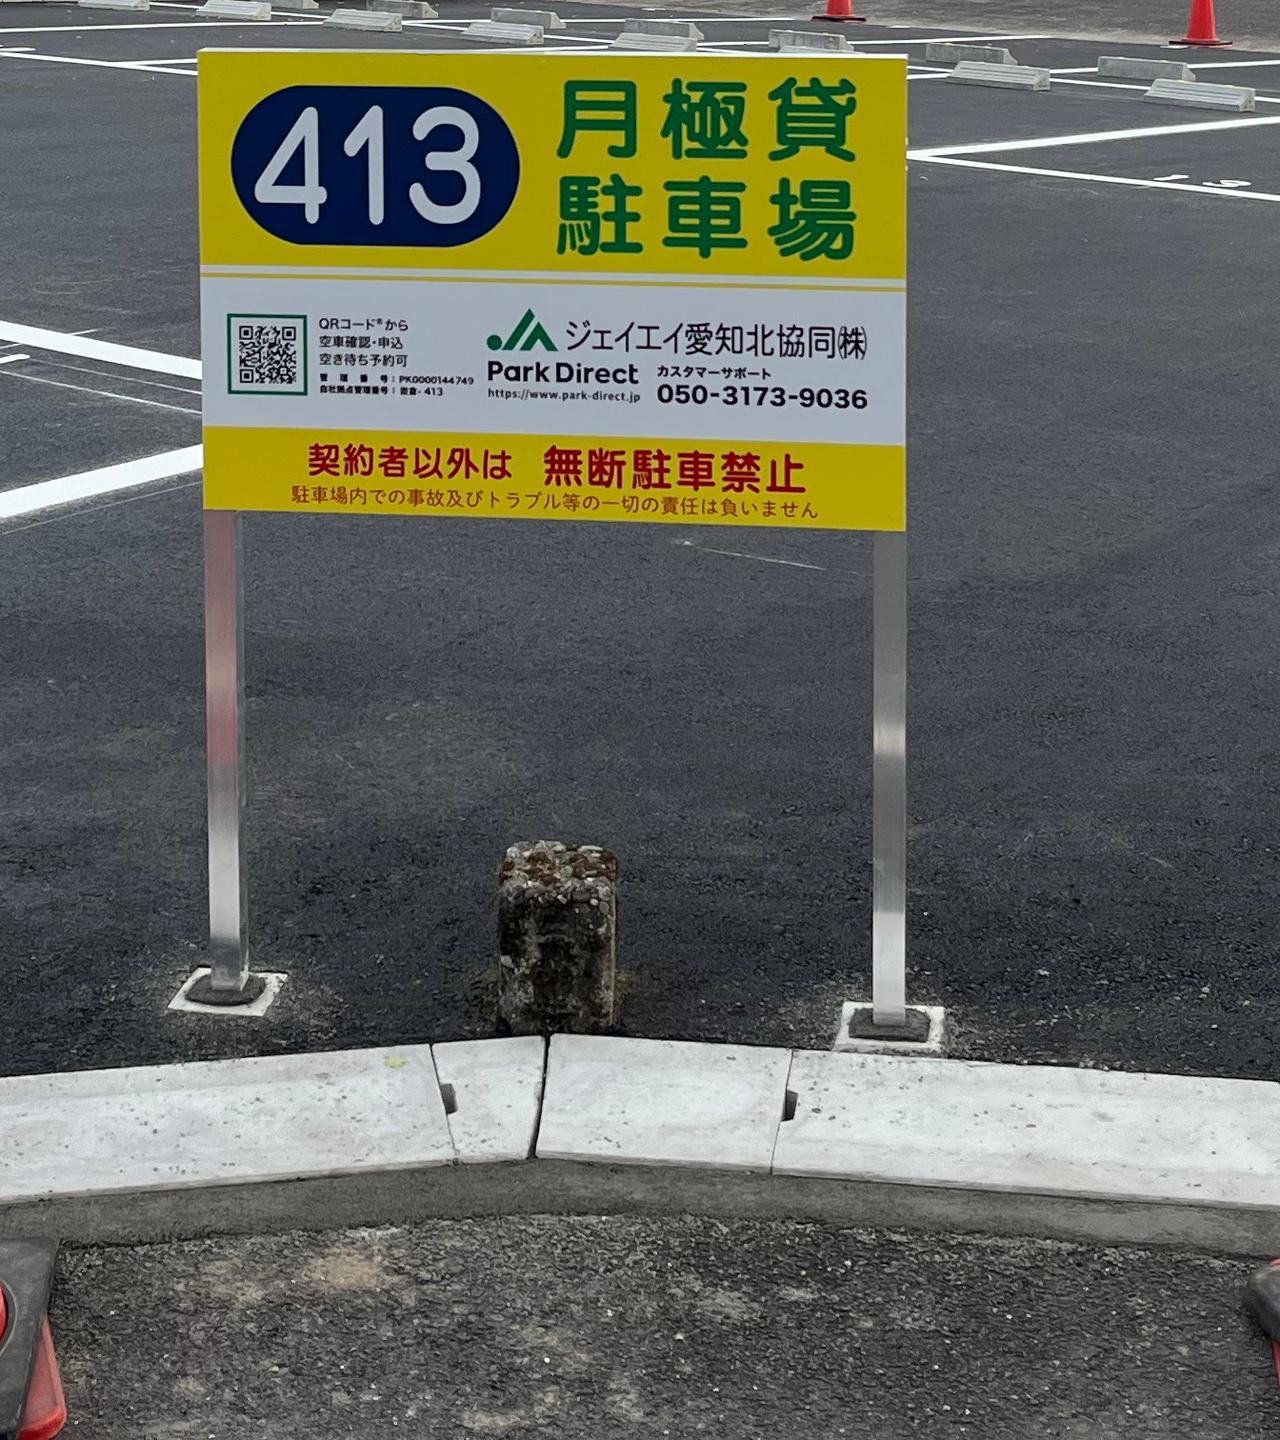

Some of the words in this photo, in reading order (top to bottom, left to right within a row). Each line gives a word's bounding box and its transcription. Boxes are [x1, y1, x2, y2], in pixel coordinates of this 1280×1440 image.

[556, 78, 857, 162] 月極貸
[254, 105, 481, 226] 413
[557, 173, 856, 263] 駐車場
[319, 353, 408, 367] 空き待ち予約可
[487, 360, 550, 383] Park
[556, 361, 639, 385] Direct
[657, 365, 772, 380] カスタマーサポート
[488, 388, 640, 403] https://www.park-direct.jp
[657, 384, 868, 409] 050-3173-9036
[308, 443, 512, 480] 契約者以外は
[544, 445, 806, 494] 無断駐車禁止
[291, 485, 819, 519] 駐車場内での事故及びトラブル等の一切の責任は負いません
